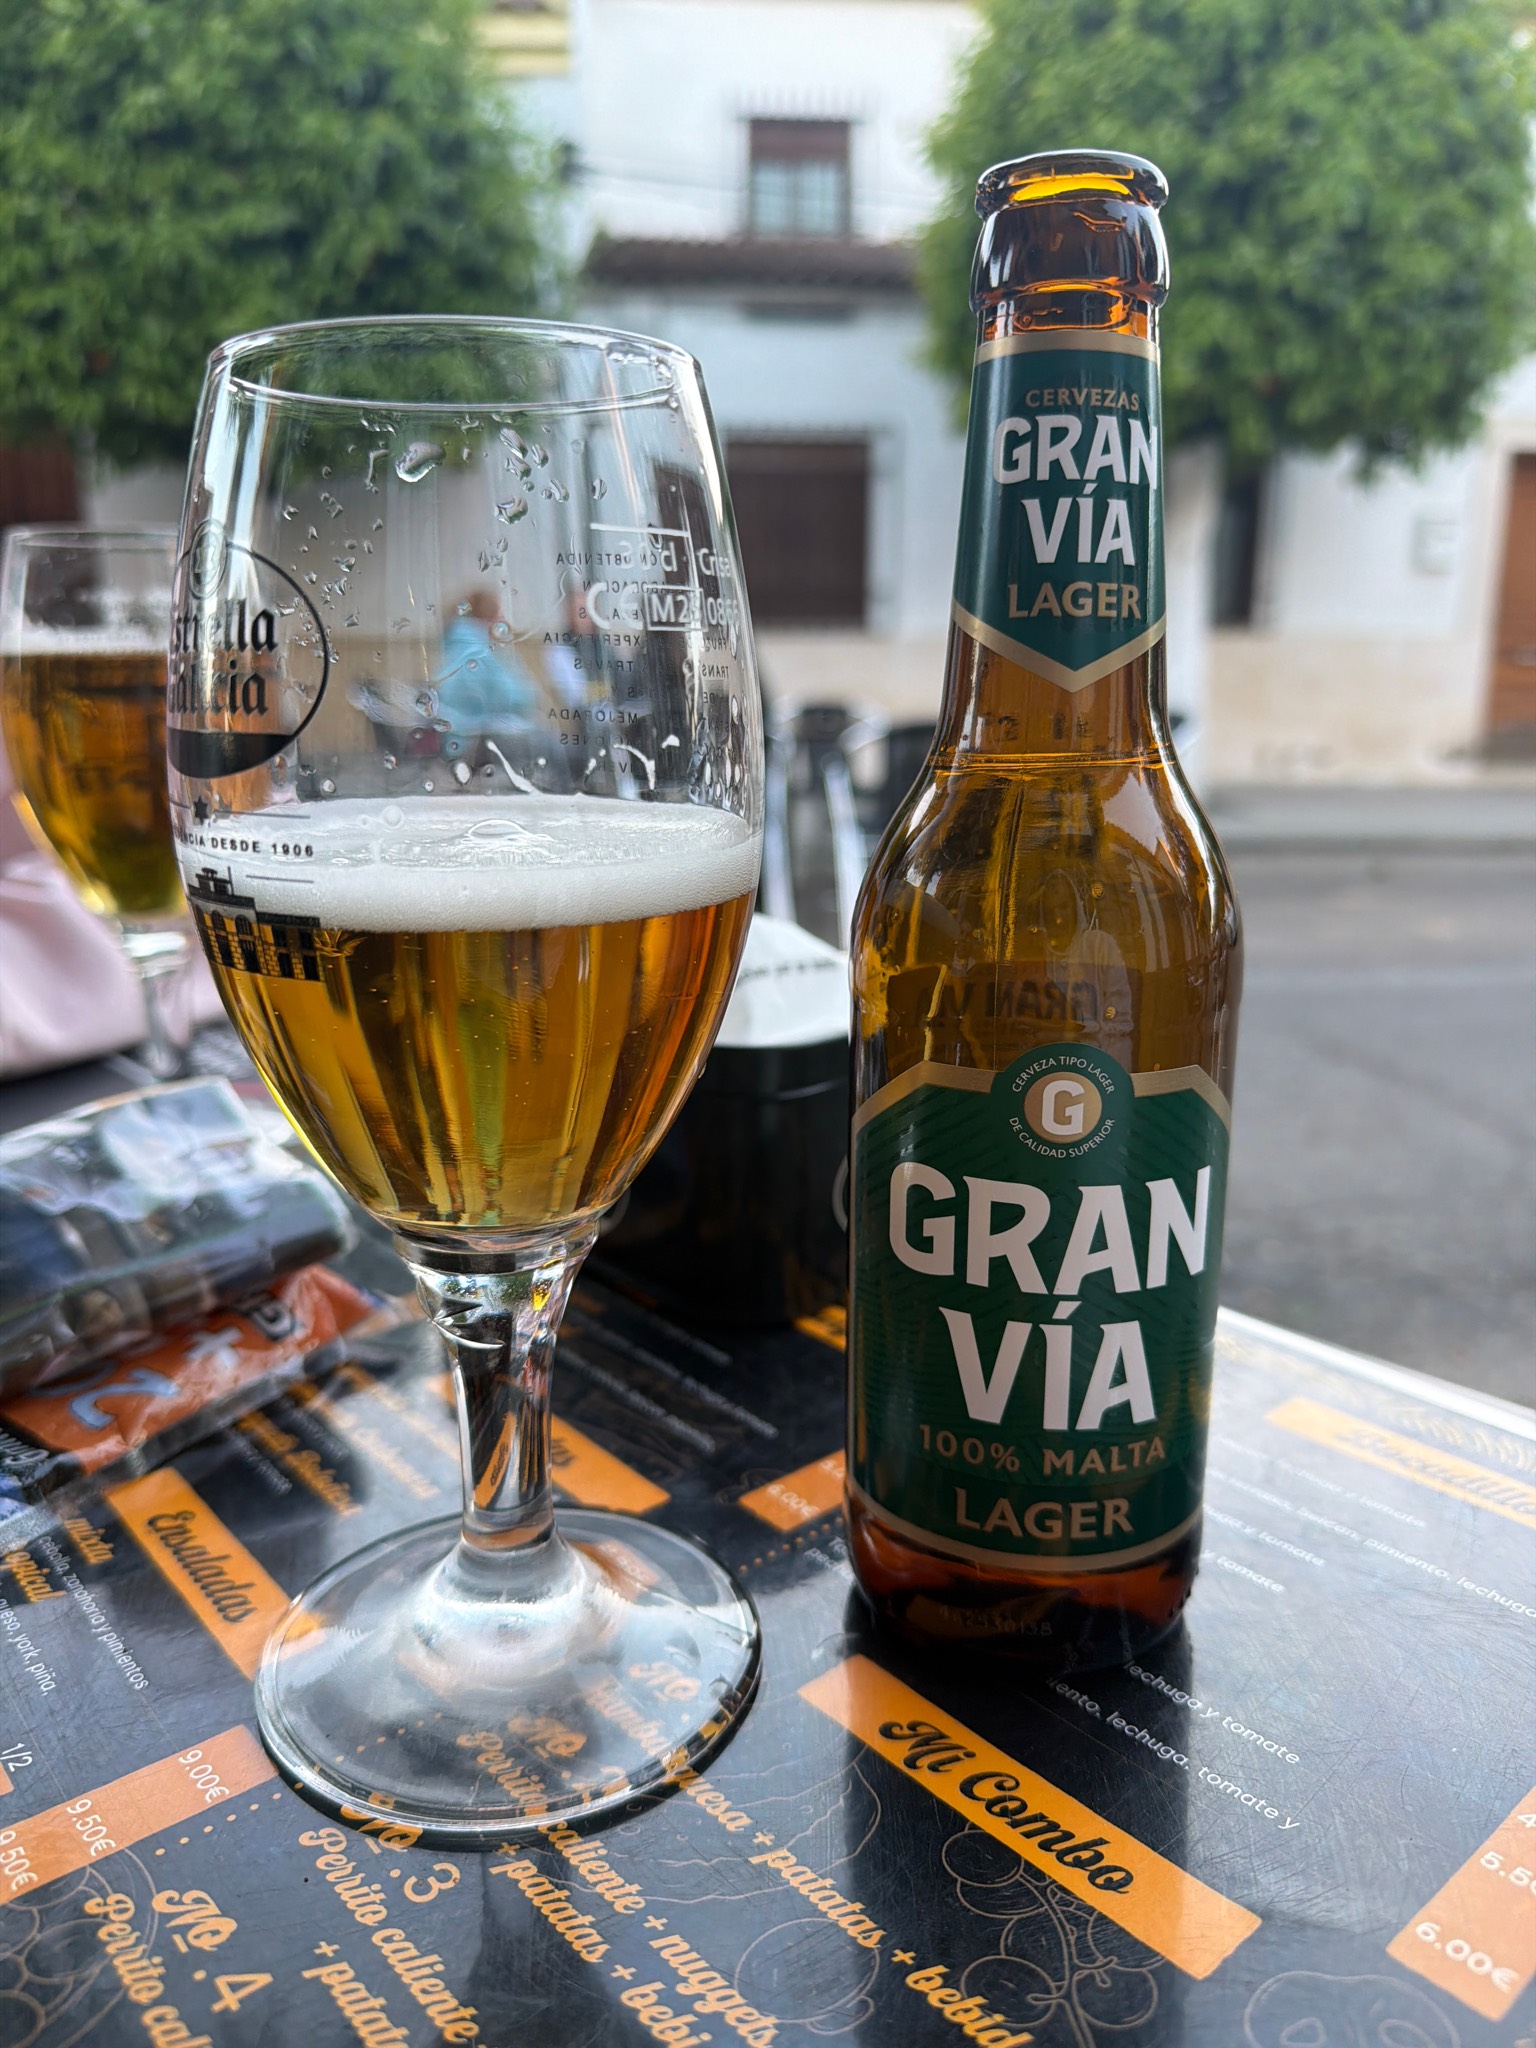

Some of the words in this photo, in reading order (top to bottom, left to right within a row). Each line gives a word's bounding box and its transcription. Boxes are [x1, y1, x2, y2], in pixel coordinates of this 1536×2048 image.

[1025, 387, 1139, 411] CERVEZAS
[993, 415, 1157, 490] GRAN
[1021, 484, 1135, 566] VÍA
[1008, 581, 1141, 620] LAGER
[211, 837, 261, 854] DESDE
[271, 842, 315, 858] 1906
[1012, 1058, 1057, 1092] CERVEZA
[1059, 1056, 1087, 1068] TIPO
[1087, 1063, 1115, 1094] LAGER
[1009, 1117, 1023, 1133] DE
[1018, 1132, 1067, 1158] CALIDAD
[1069, 1118, 1115, 1158] SUPERIOR
[1041, 1080, 1085, 1136] G
[889, 1161, 1212, 1296] GRAN
[938, 1300, 1157, 1431] VÍA
[919, 1424, 1021, 1474] 100%
[1042, 1436, 1167, 1477] MALTA
[954, 1486, 1135, 1540] LAGER
[147, 1510, 258, 1623] Ensaladas
[8, 1632, 43, 1665] york,
[91, 1621, 112, 1635] y
[25, 1661, 57, 1697] piña,
[98, 1631, 149, 1691] pimientos
[1124, 1660, 1202, 1711] lechuga
[1199, 1706, 1220, 1720] y
[1222, 1715, 1301, 1765] tomate
[178, 1747, 230, 1803] 9.00€
[1197, 1766, 1280, 1820] tomate
[1278, 1816, 1300, 1830] y
[66, 1797, 116, 1857] 9.50€
[879, 1720, 977, 1774] Mi
[959, 1771, 1134, 1895] Combo
[489, 1858, 612, 1963] patatas
[748, 1848, 887, 1948] patatas
[84, 1892, 167, 2006] Perrito
[298, 1827, 388, 1927] Perrito
[372, 1928, 480, 2045] caliente
[538, 1820, 646, 1914] caliente
[648, 1934, 780, 2048] nuggets
[1415, 1921, 1520, 1994] 6.00€
